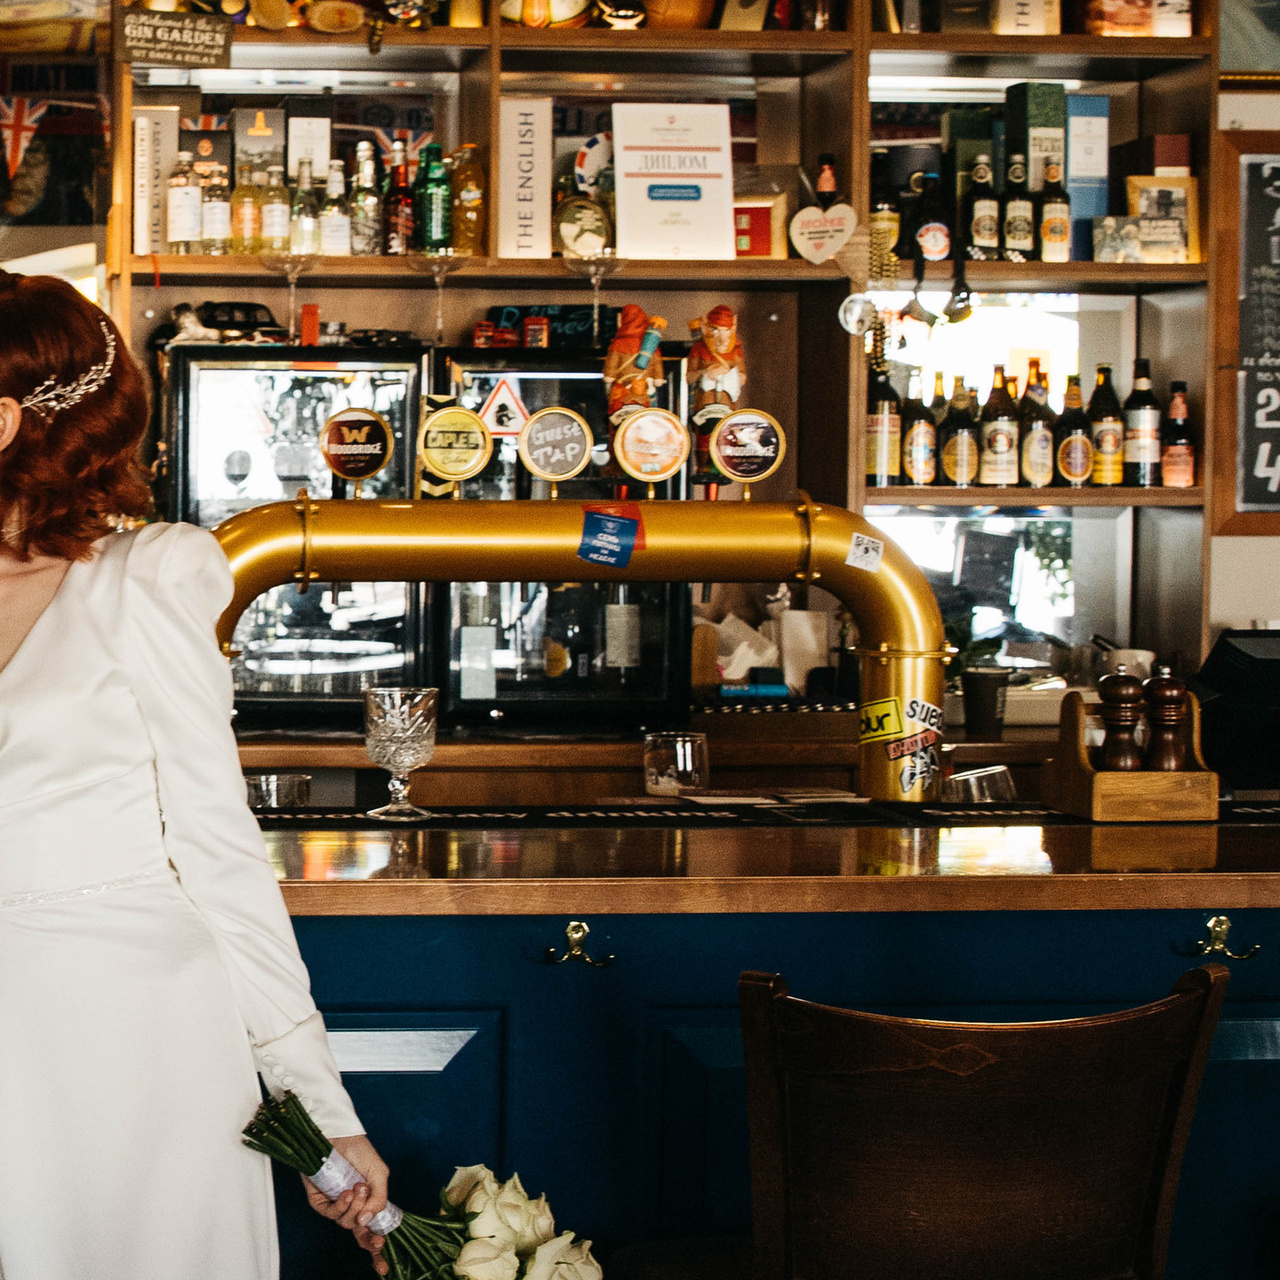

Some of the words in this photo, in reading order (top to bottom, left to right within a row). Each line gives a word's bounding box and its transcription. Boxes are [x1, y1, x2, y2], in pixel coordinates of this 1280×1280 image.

[124, 23, 154, 39] GIN
[155, 26, 226, 46] GARDEN
[517, 112, 534, 203] ENGLISH
[639, 154, 708, 172] ДИПЛОМ
[517, 211, 534, 252] THE
